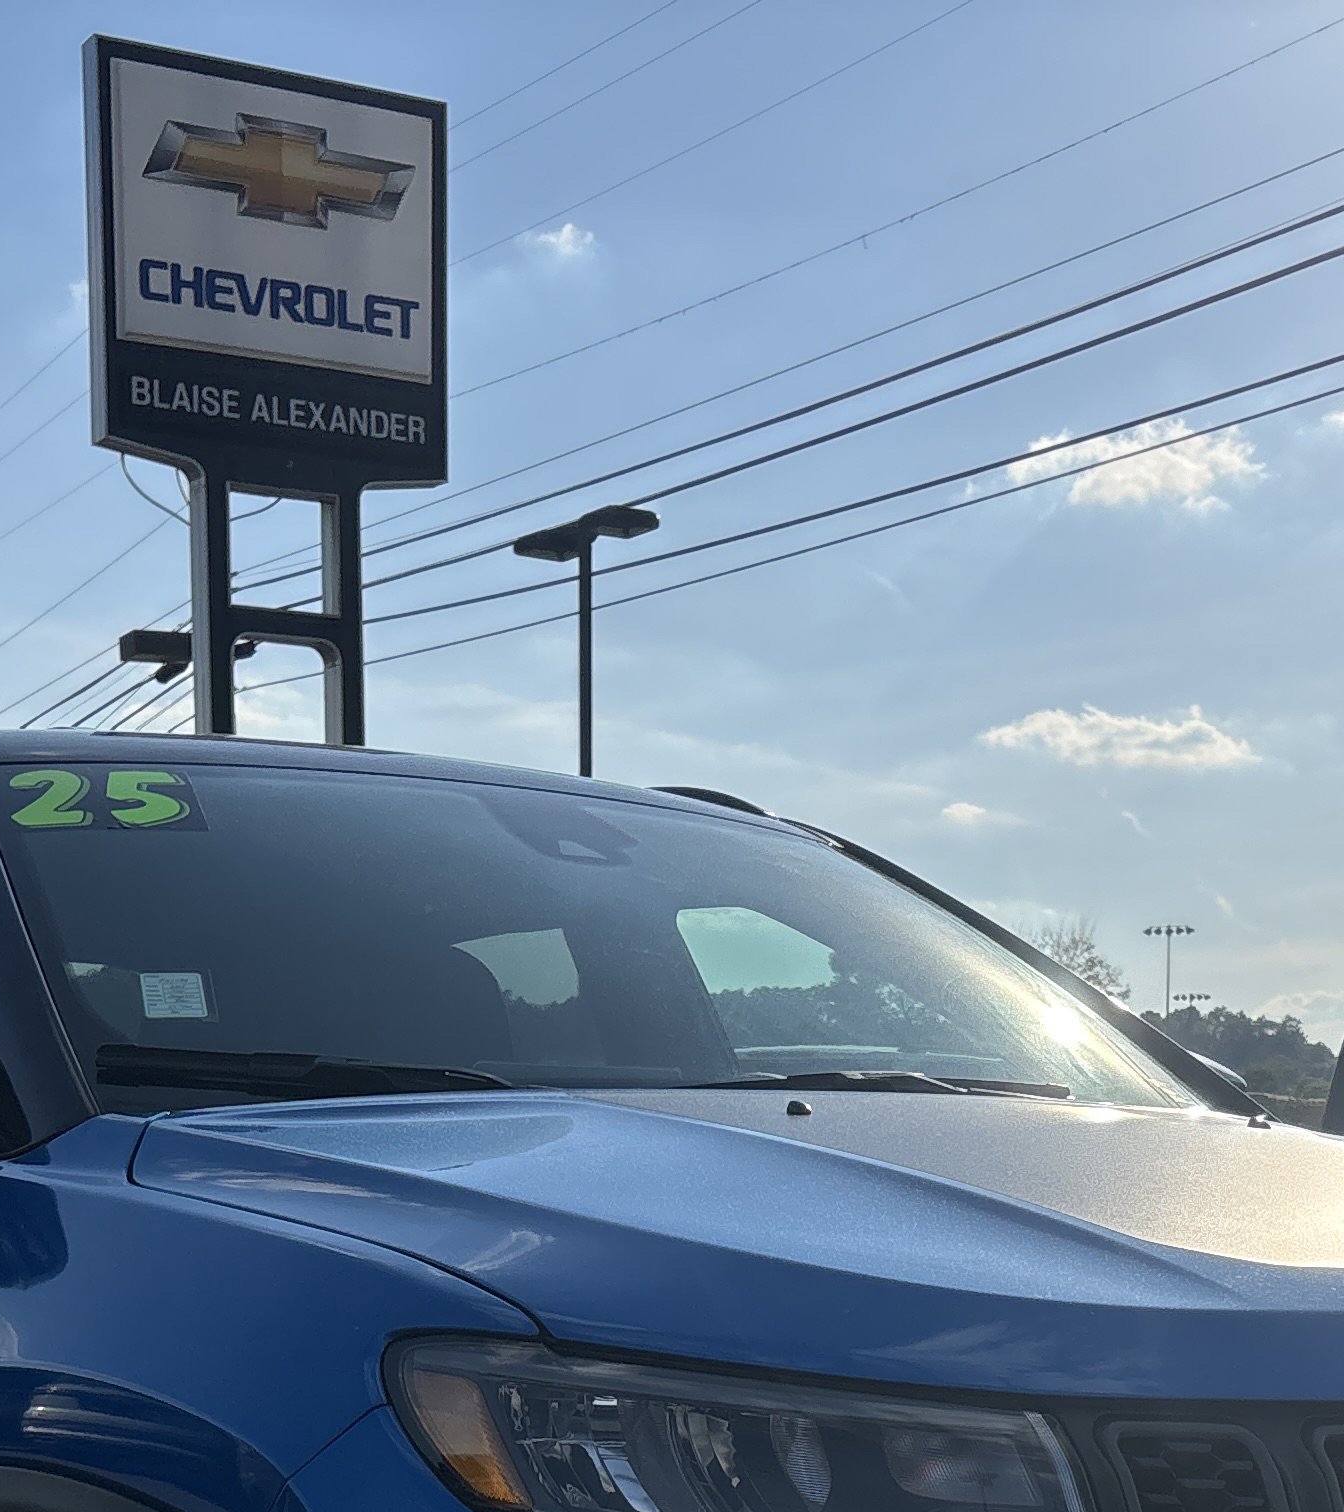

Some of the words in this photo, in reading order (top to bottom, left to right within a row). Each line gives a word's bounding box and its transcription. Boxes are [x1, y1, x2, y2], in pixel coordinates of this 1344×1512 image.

[138, 257, 420, 340] CHEVROLET
[130, 375, 241, 420] BLAISE
[251, 393, 426, 445] ALEXANDER
[9, 768, 191, 829] 25
